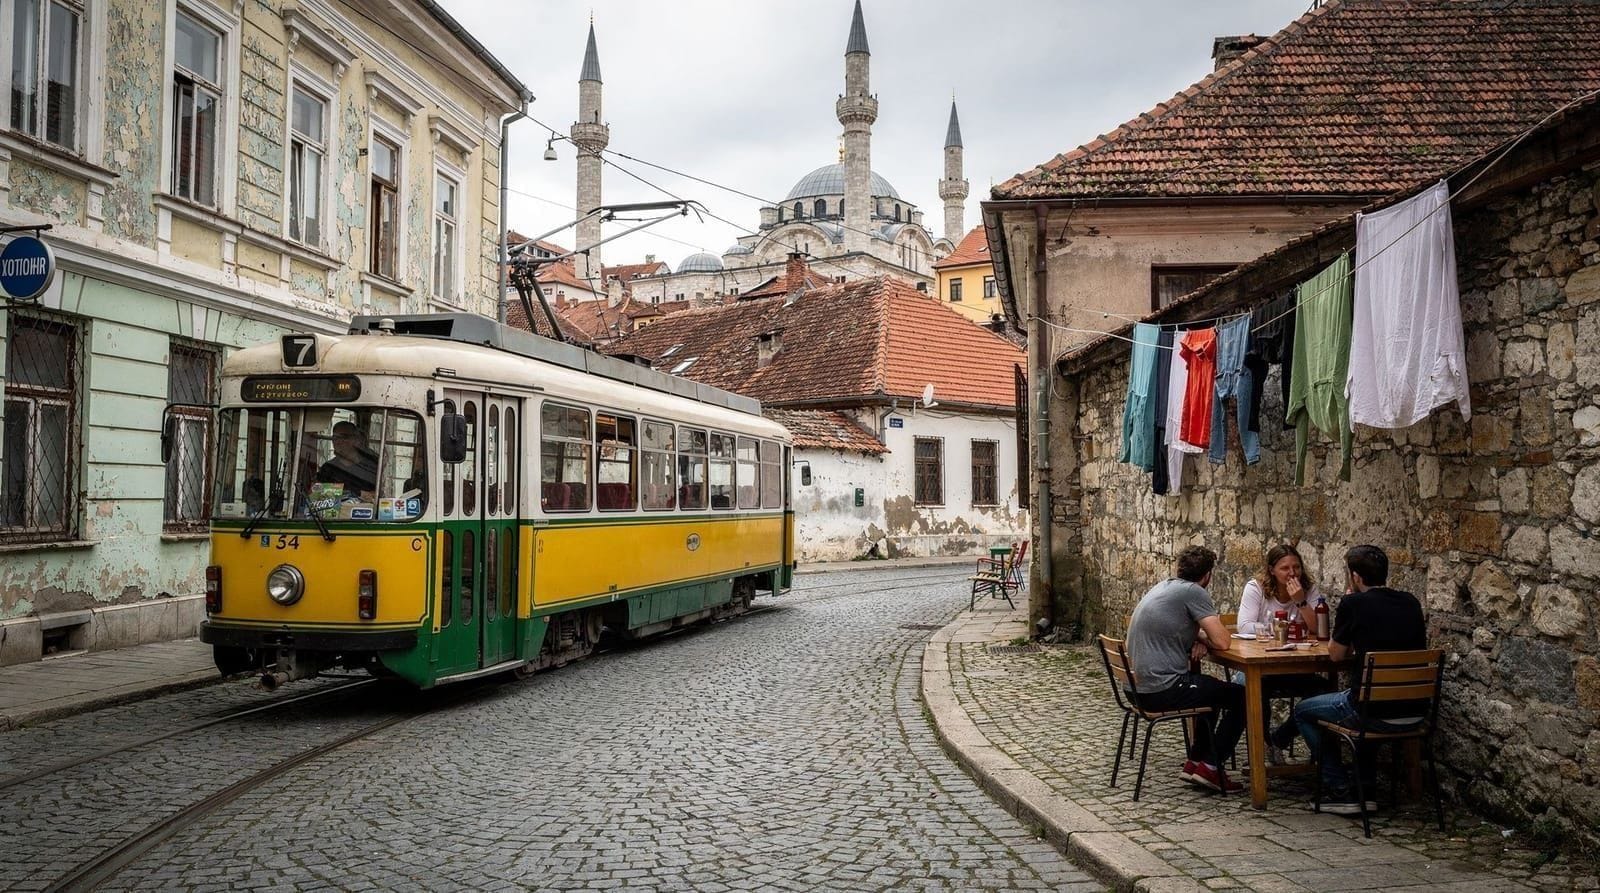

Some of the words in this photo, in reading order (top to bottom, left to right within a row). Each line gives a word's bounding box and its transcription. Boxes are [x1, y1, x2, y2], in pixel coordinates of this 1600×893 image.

[293, 339, 314, 365] 7
[276, 535, 299, 550] 54
[411, 538, 422, 551] C
